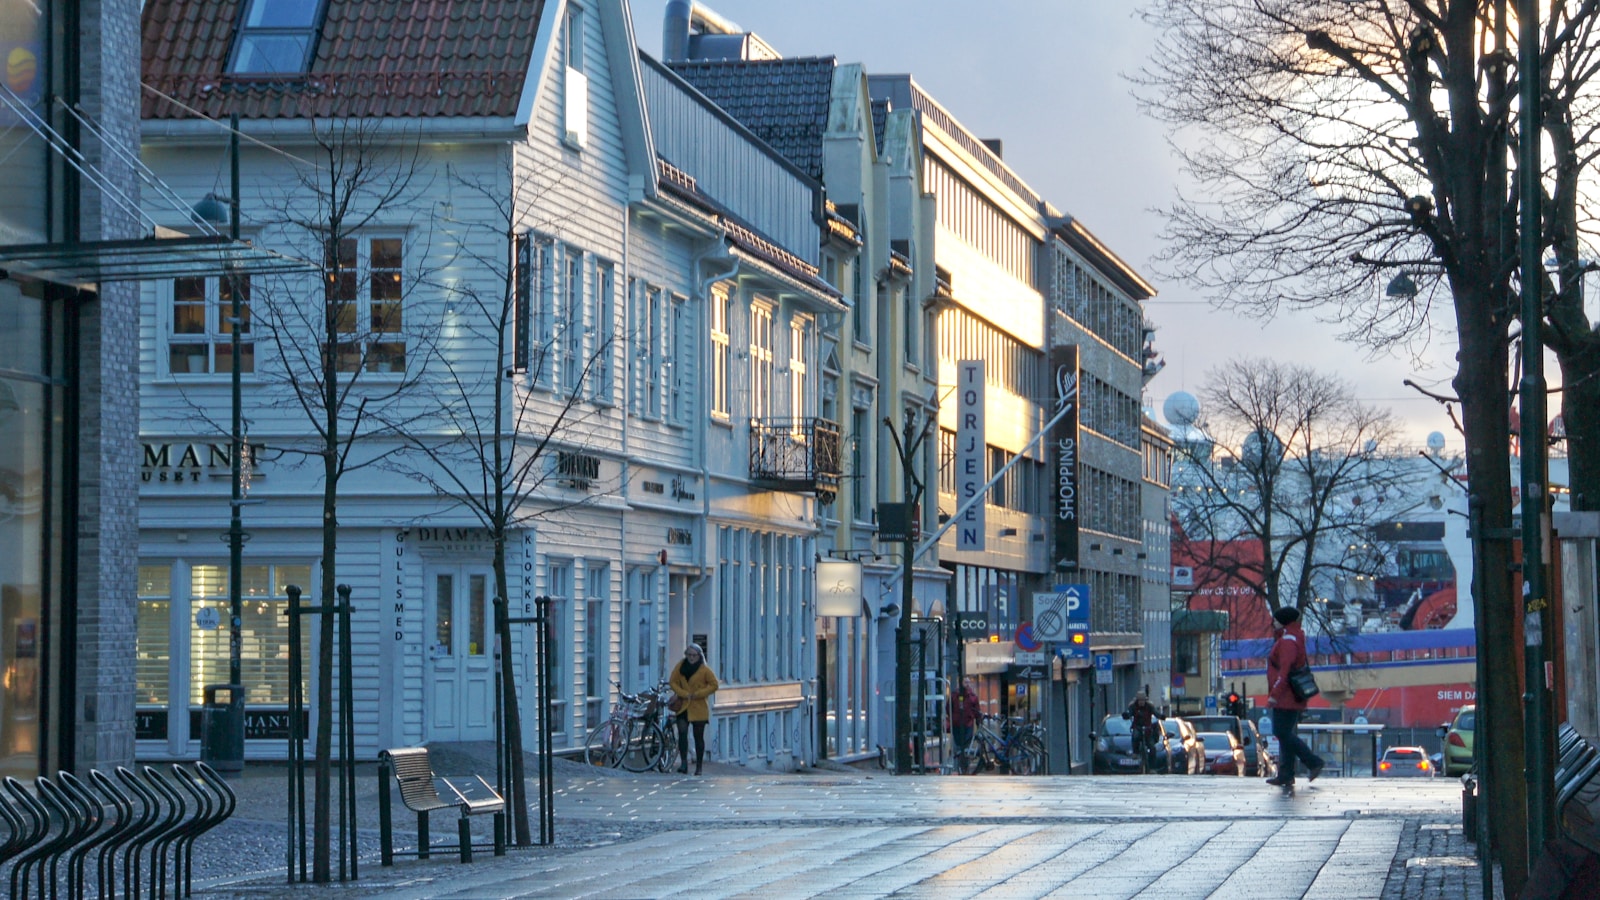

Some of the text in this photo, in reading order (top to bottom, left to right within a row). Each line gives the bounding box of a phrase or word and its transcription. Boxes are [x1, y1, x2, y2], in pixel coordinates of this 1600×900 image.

[964, 366, 977, 545] TORJESEN
[1059, 437, 1074, 520] SHOPPING
[394, 532, 404, 641] GULLSMED
[1066, 596, 1080, 617] P
[1099, 656, 1108, 667] P
[1206, 697, 1214, 708] P
[1437, 690, 1462, 700] SIEM
